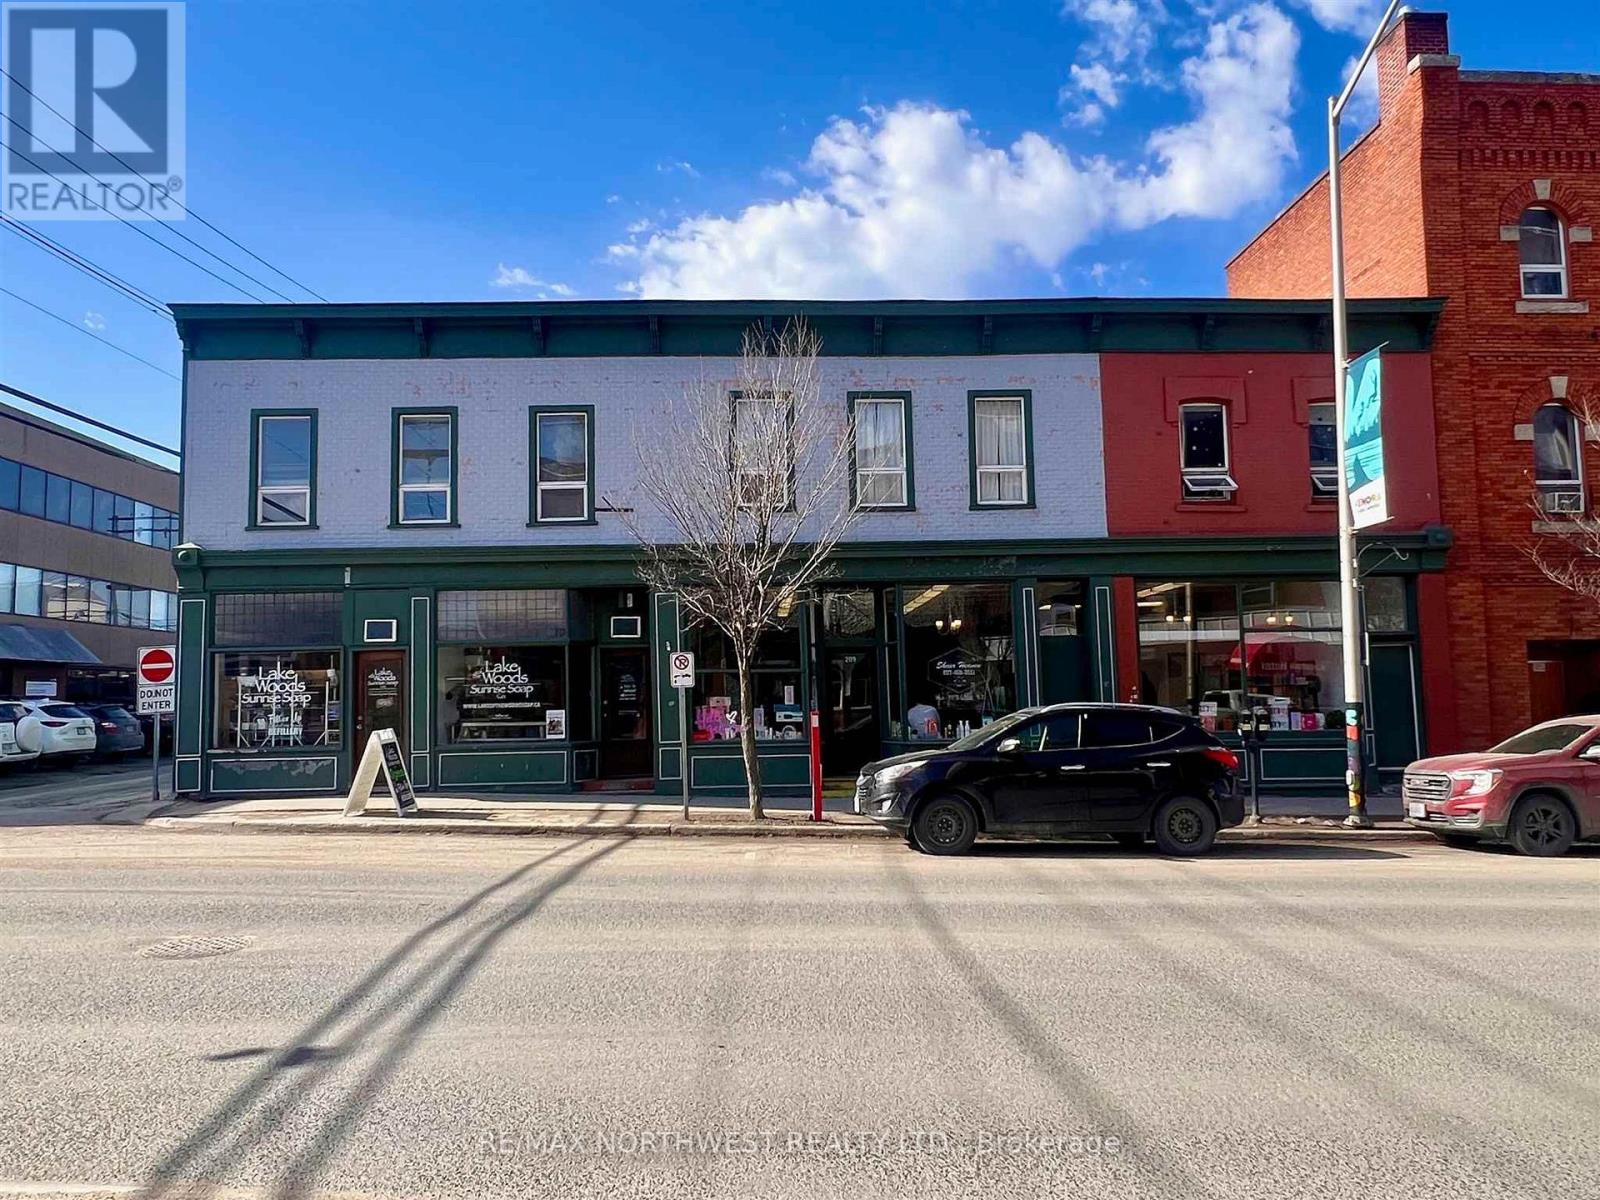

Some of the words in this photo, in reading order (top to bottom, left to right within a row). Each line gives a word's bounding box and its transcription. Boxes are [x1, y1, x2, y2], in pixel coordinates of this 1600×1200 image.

[258, 661, 297, 680] Lake
[485, 656, 519, 673] Lake
[255, 674, 306, 693] Woods
[482, 667, 529, 684] Woods
[140, 690, 153, 699] DO
[155, 688, 173, 698] NOT
[507, 683, 534, 698] Soap
[141, 700, 171, 710] ENTER
